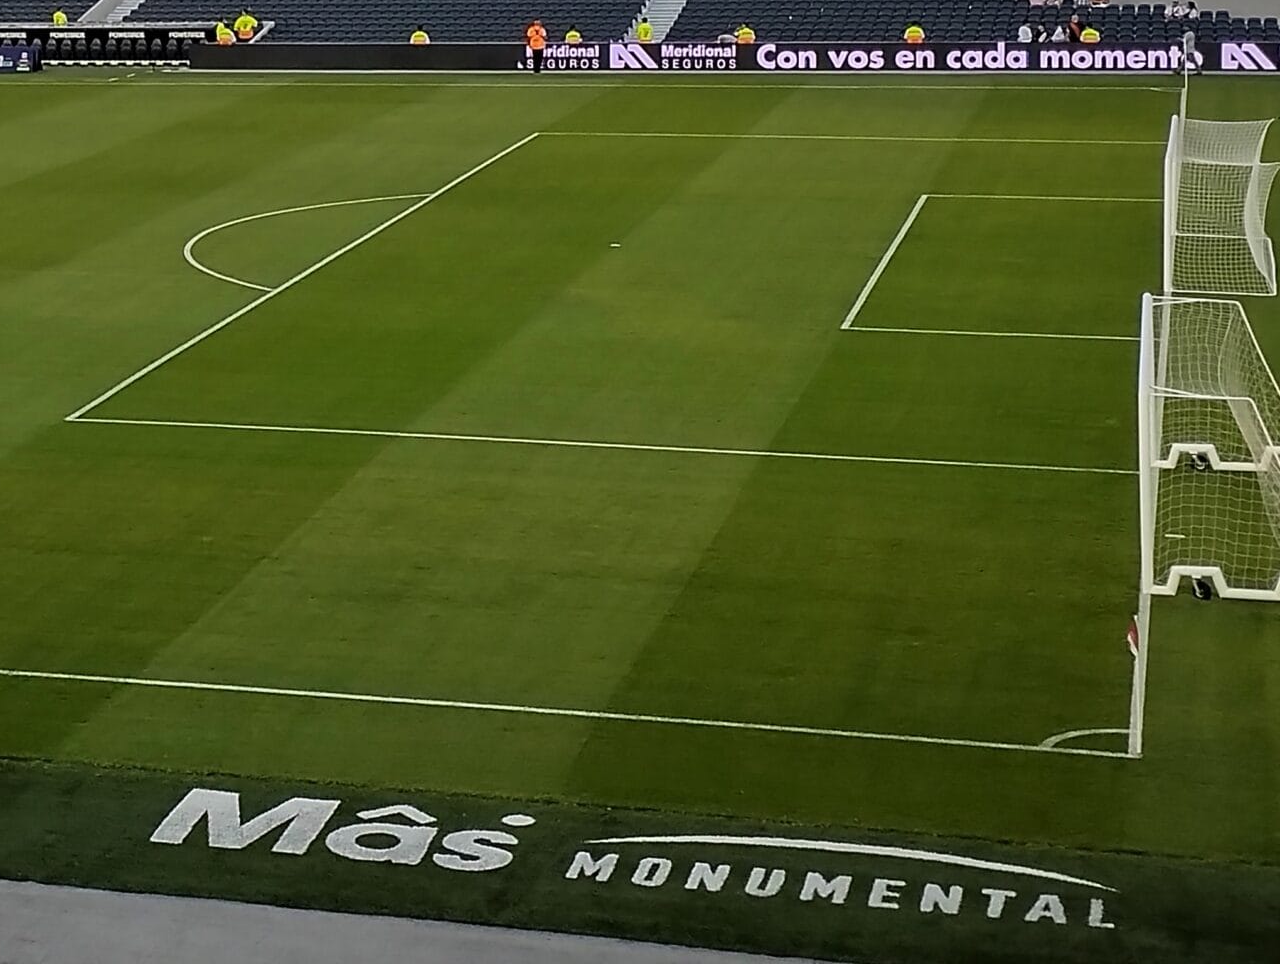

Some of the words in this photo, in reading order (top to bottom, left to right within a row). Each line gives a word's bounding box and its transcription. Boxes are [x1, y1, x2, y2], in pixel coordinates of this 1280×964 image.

[661, 44, 736, 58] Meridional
[756, 44, 817, 69] Con
[827, 49, 884, 69] vos
[895, 49, 935, 69] en
[946, 41, 1027, 69] cada
[526, 58, 600, 69] SGUROS
[661, 59, 737, 69] SEGUROS
[564, 849, 1116, 930] MONUMENTAL
